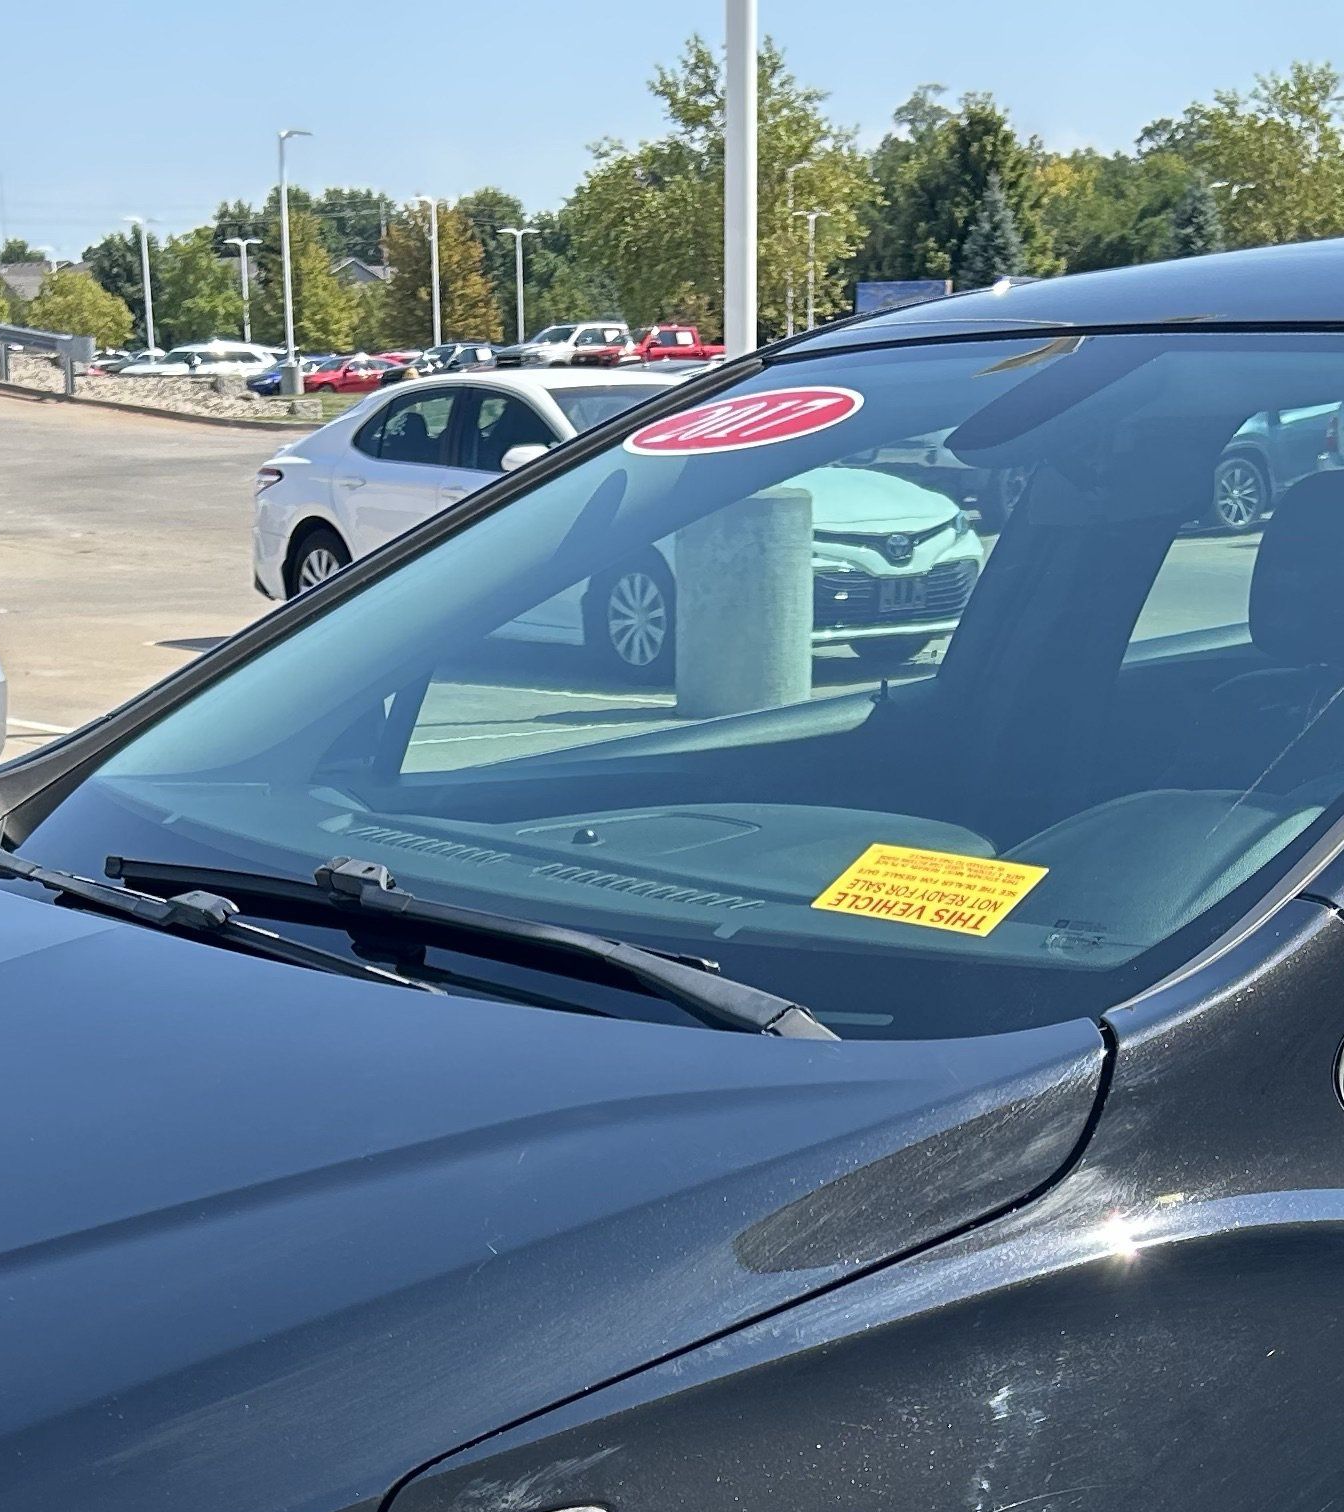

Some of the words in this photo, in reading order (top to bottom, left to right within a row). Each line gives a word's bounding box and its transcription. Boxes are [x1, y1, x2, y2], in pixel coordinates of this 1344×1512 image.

[641, 398, 844, 445] 2017
[855, 867, 881, 875] DATE
[880, 871, 918, 881] RESALE
[844, 878, 888, 893] SALE
[917, 876, 940, 885] FOR
[939, 880, 978, 890] DEALER
[882, 884, 919, 898] FOR
[976, 885, 998, 894] THE
[997, 889, 1019, 897] SEE
[913, 889, 971, 906] READY
[965, 897, 1004, 912] NOT
[827, 892, 928, 920] VEHICLE
[926, 907, 991, 930] THIS
